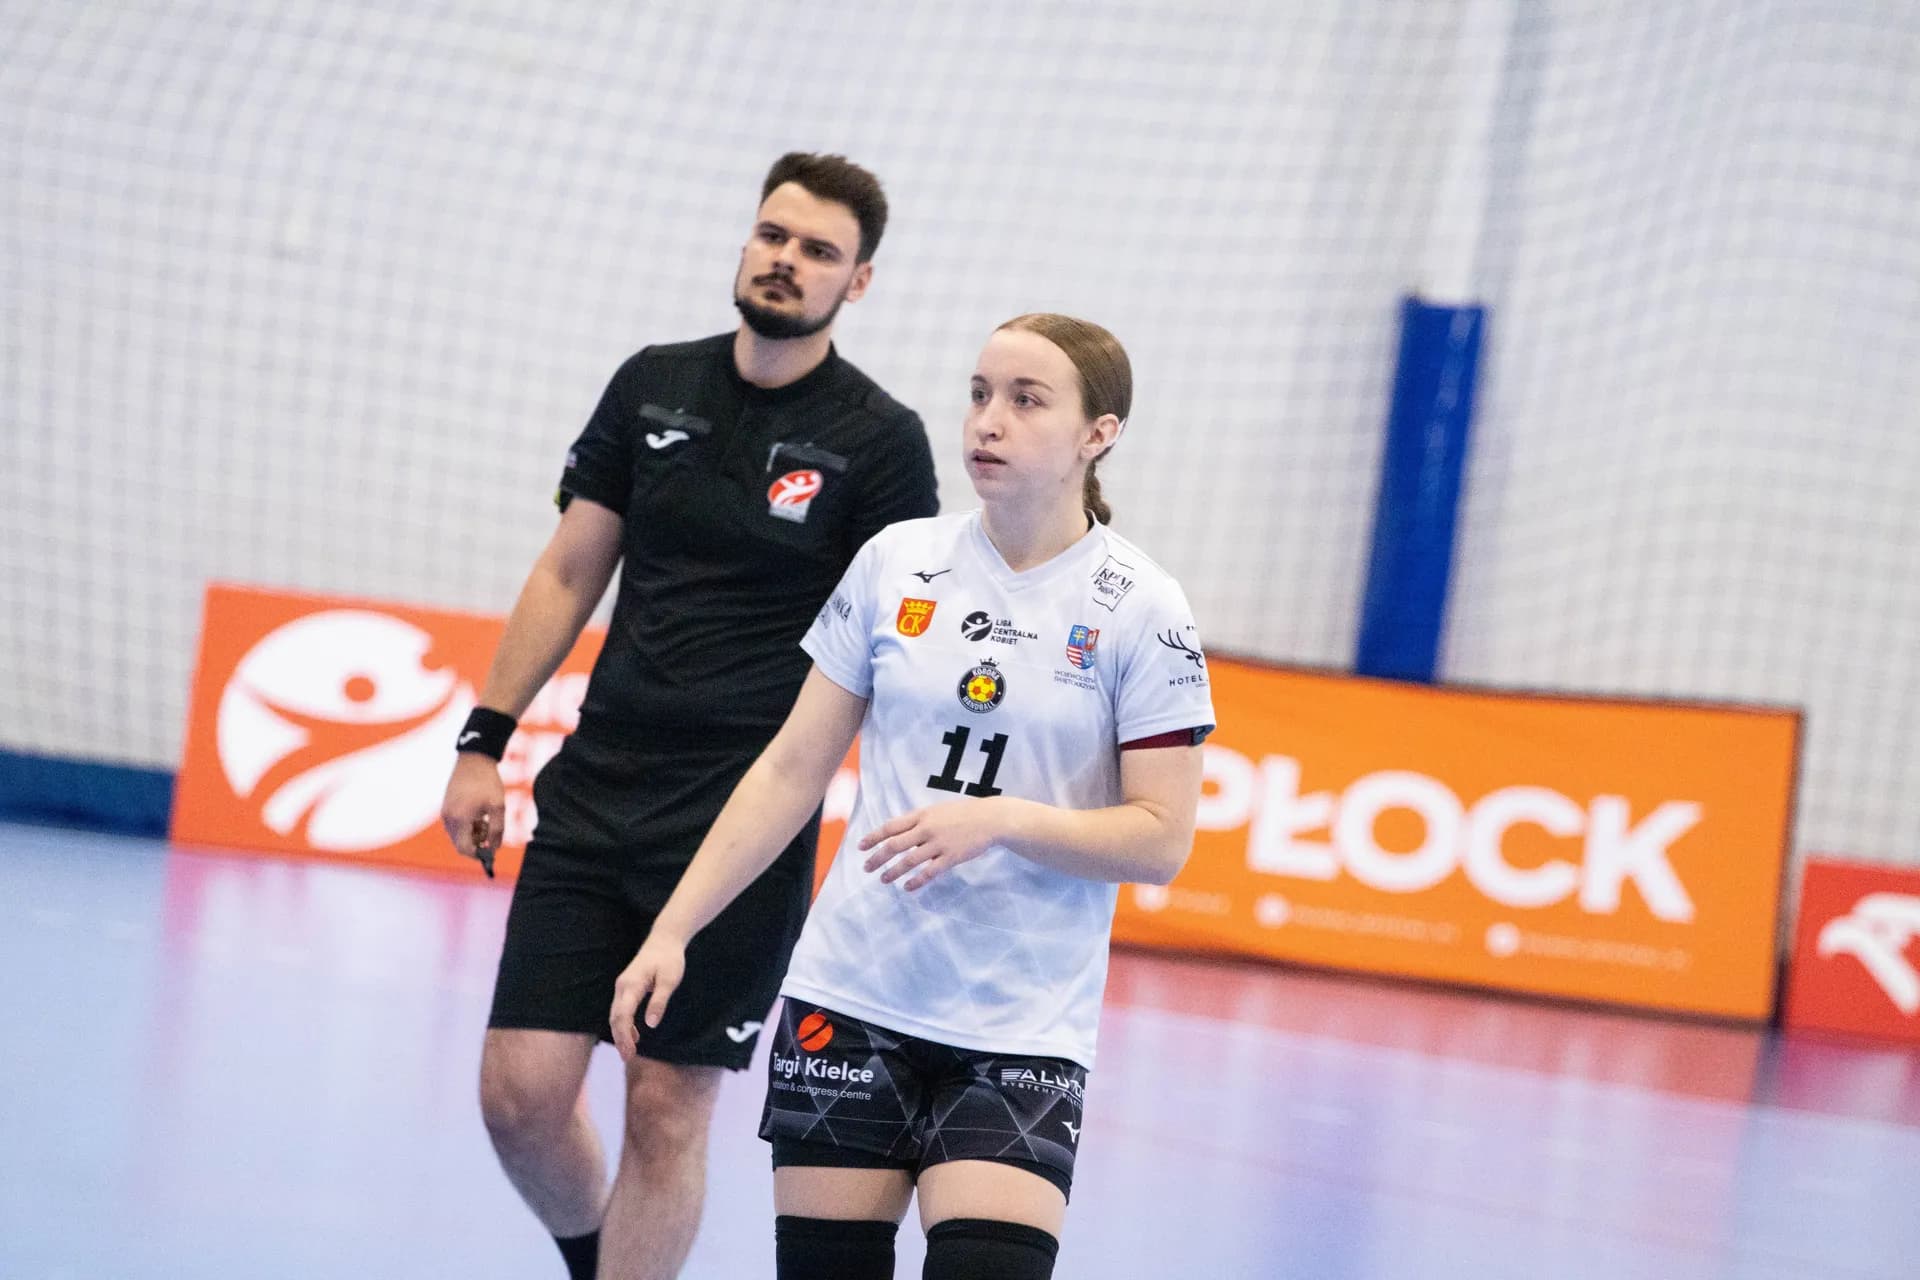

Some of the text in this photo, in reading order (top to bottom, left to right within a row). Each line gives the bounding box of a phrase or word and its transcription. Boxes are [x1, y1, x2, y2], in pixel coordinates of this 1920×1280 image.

[899, 614, 926, 634] CK
[996, 619, 1012, 627] LIGA
[990, 635, 1018, 645] KOBIET
[993, 627, 1038, 640] CENTRALNA
[1169, 674, 1203, 687] HOTEL
[926, 725, 1009, 798] 11
[1195, 743, 1702, 922] PŁOCK
[773, 1052, 874, 1083] Targi Kielce
[790, 1082, 796, 1092] &
[796, 1084, 838, 1096] congress
[839, 1090, 872, 1101] centre
